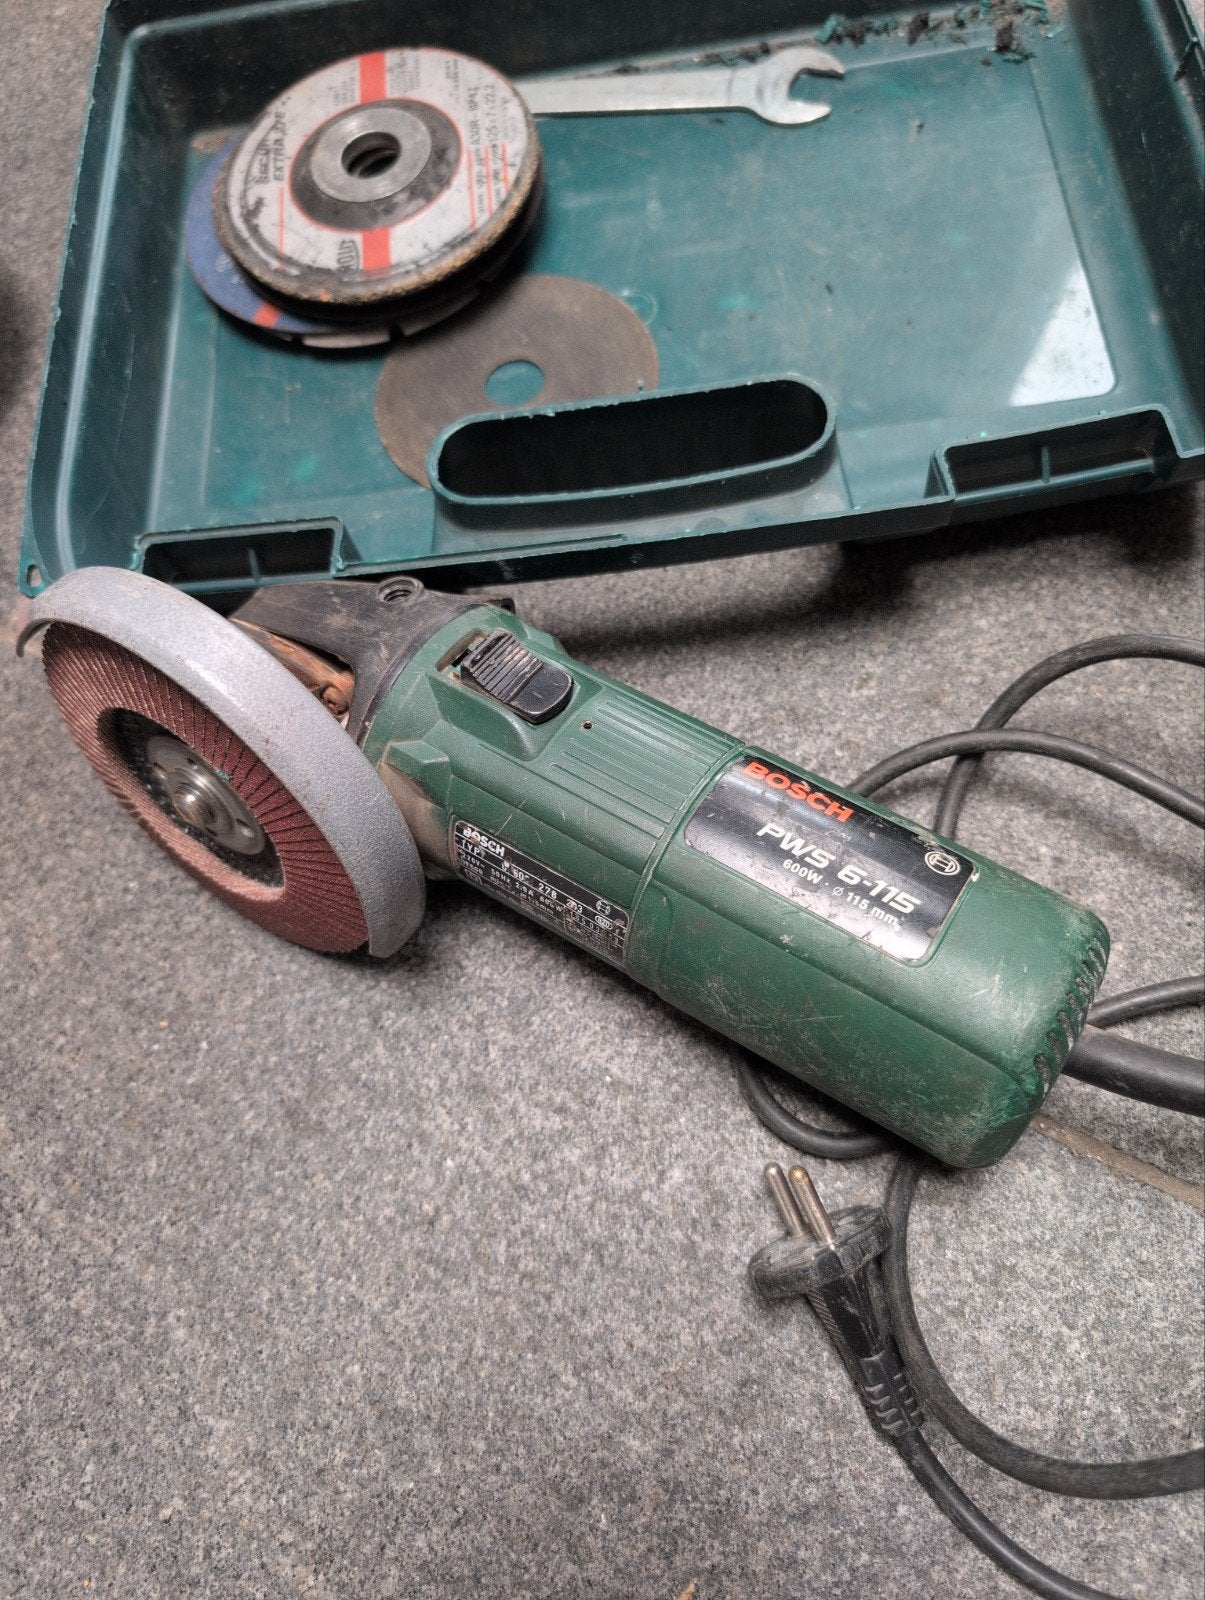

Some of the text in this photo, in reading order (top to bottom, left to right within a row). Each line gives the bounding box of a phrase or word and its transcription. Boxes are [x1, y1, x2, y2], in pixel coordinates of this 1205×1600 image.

[742, 760, 854, 823] BOSCH
[462, 827, 506, 857] BOSCH
[756, 823, 922, 914] PWS 6-115
[538, 882, 558, 900] 278
[782, 859, 824, 885] 600W
[846, 892, 870, 910] 115
[870, 906, 900, 926] mm
